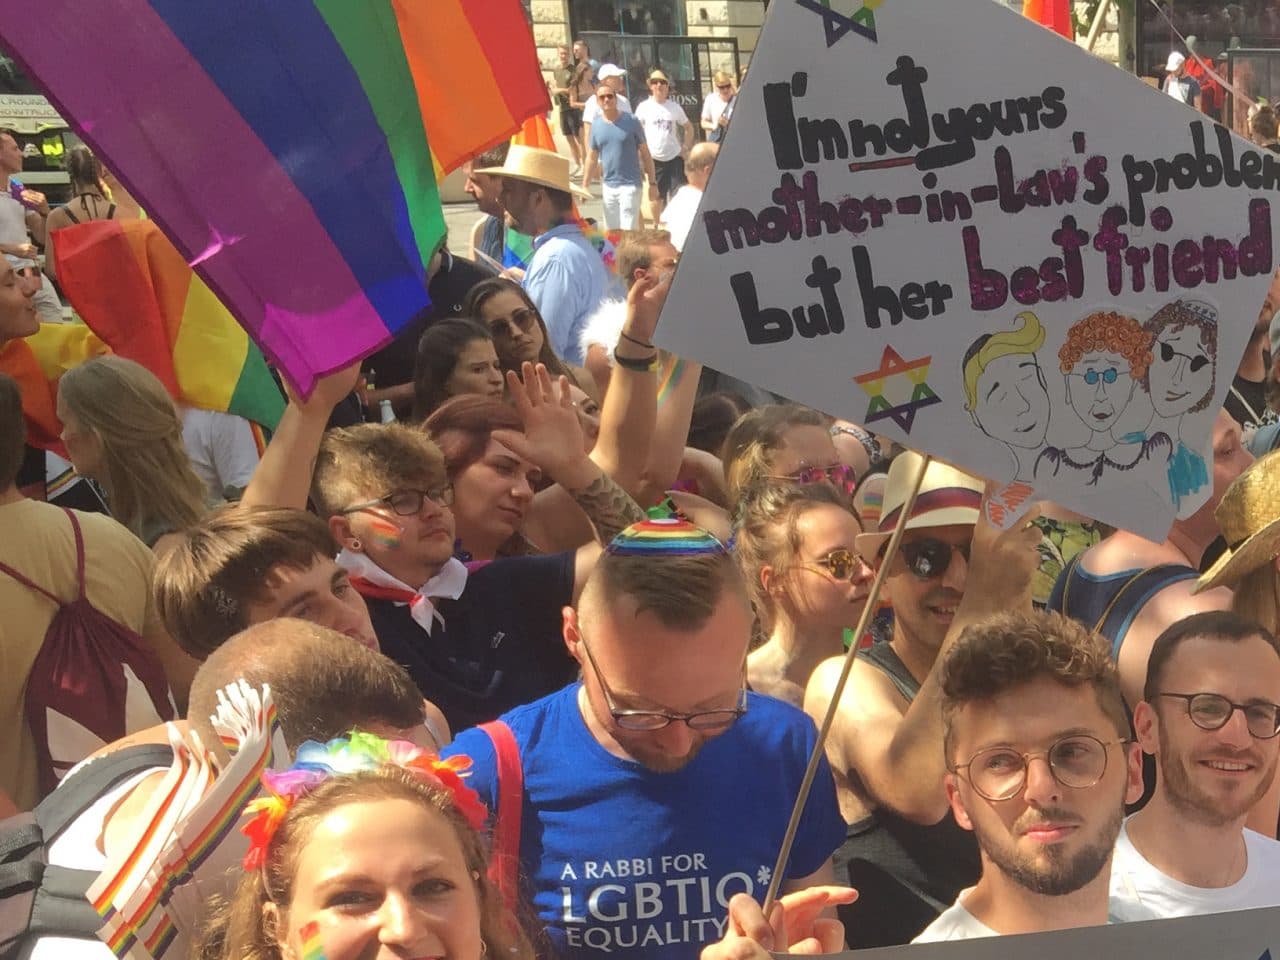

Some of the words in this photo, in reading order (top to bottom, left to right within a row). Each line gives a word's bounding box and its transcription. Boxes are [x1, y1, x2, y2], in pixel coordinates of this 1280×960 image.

[763, 71, 849, 170] I'm
[848, 55, 930, 159] not
[914, 86, 1067, 171] yours
[730, 255, 845, 345] but
[852, 245, 952, 328] her
[961, 215, 1090, 312] best
[1093, 197, 1272, 297] friend
[560, 862, 578, 881] A
[584, 857, 653, 880] RABBI
[661, 853, 708, 874] FOR
[566, 913, 729, 953] EQUALITY
